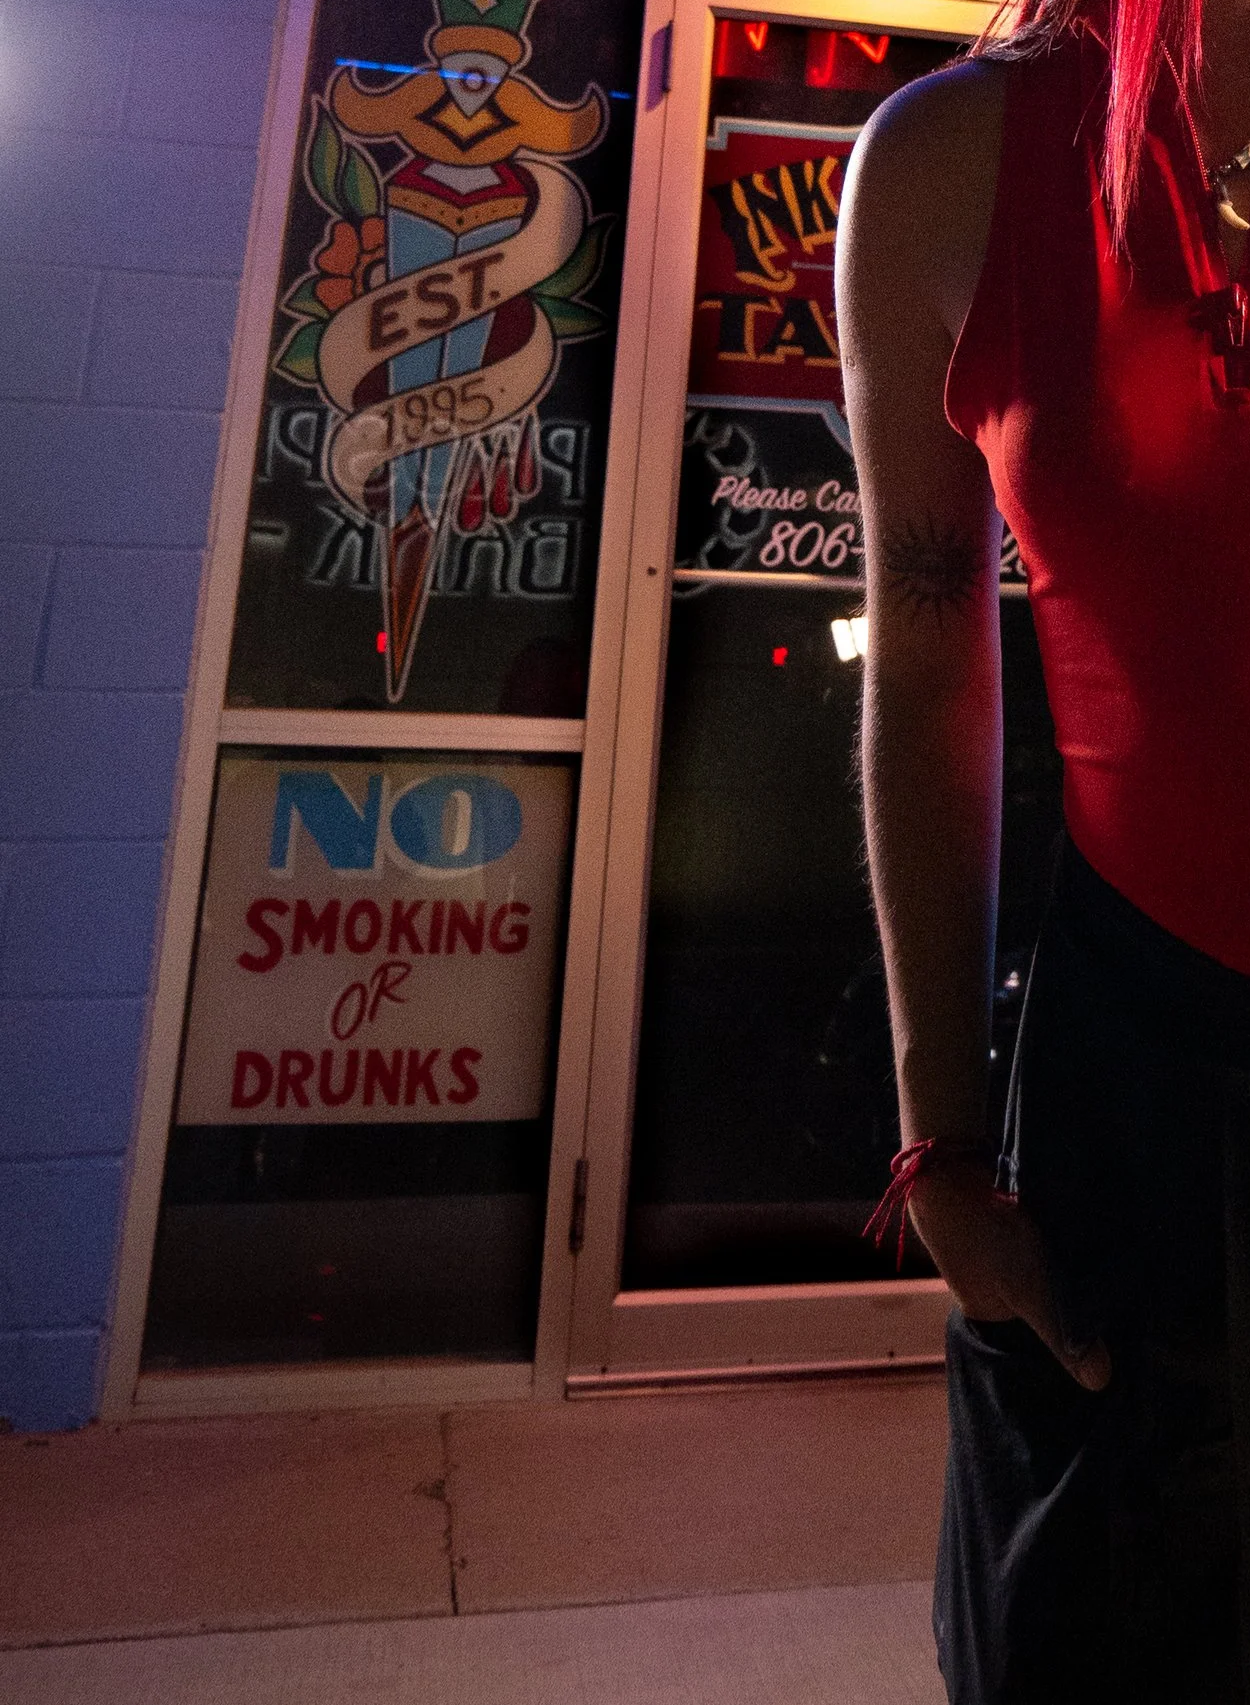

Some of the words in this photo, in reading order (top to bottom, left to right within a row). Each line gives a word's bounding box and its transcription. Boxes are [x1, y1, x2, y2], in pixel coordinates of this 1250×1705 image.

[708, 154, 848, 292] INK
[370, 252, 505, 350] EST.
[697, 292, 842, 367] TA
[381, 377, 494, 449] 1995
[711, 475, 807, 511] Please
[815, 479, 863, 513] Ca
[759, 520, 866, 569] 806-
[268, 771, 522, 874] NO
[236, 898, 531, 974] SMOKING
[330, 960, 413, 1041] OR
[230, 1046, 484, 1109] DRUNKS
